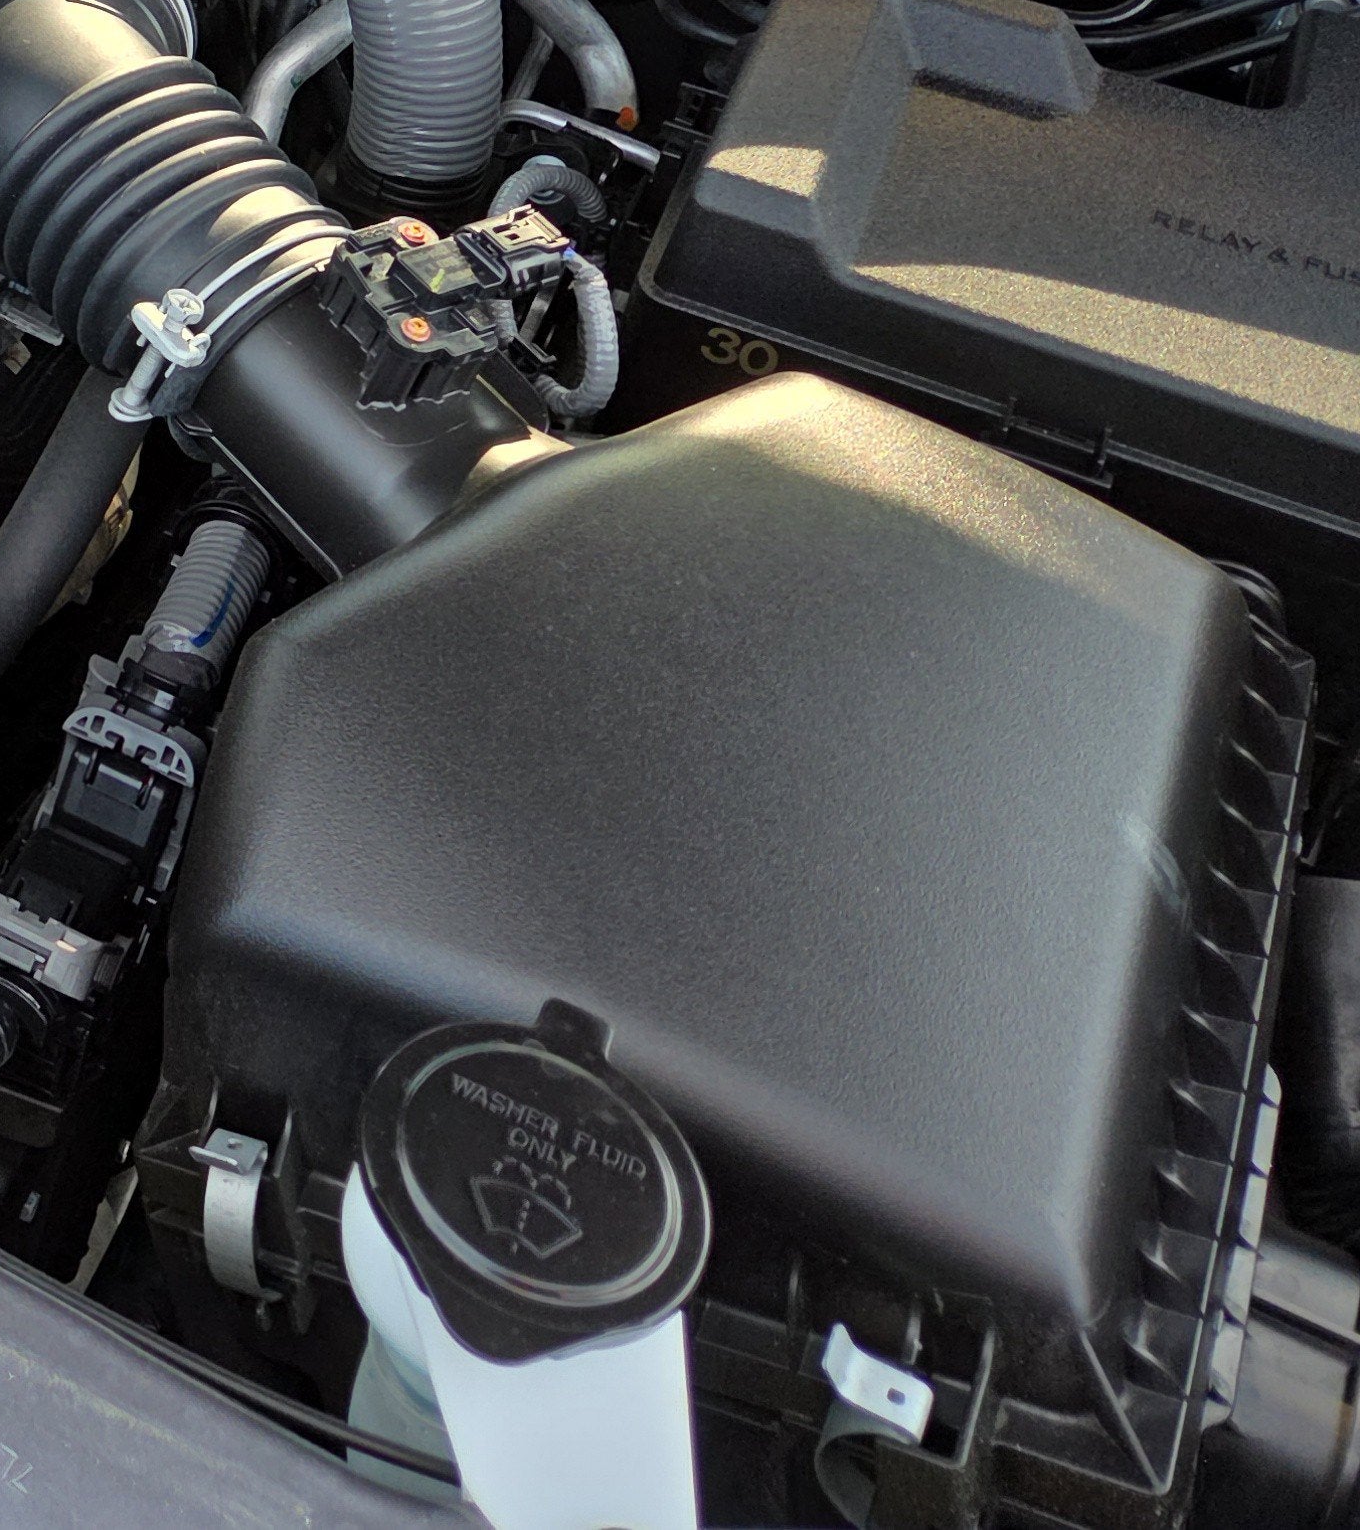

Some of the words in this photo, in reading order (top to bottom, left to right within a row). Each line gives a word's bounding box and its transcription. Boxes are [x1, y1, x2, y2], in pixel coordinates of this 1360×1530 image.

[1153, 210, 1262, 253] RELAY
[1267, 246, 1290, 266] &
[700, 327, 779, 375] 30
[451, 1072, 560, 1140] WASHER
[572, 1129, 648, 1181] FLUID
[508, 1126, 578, 1172] ONLY
